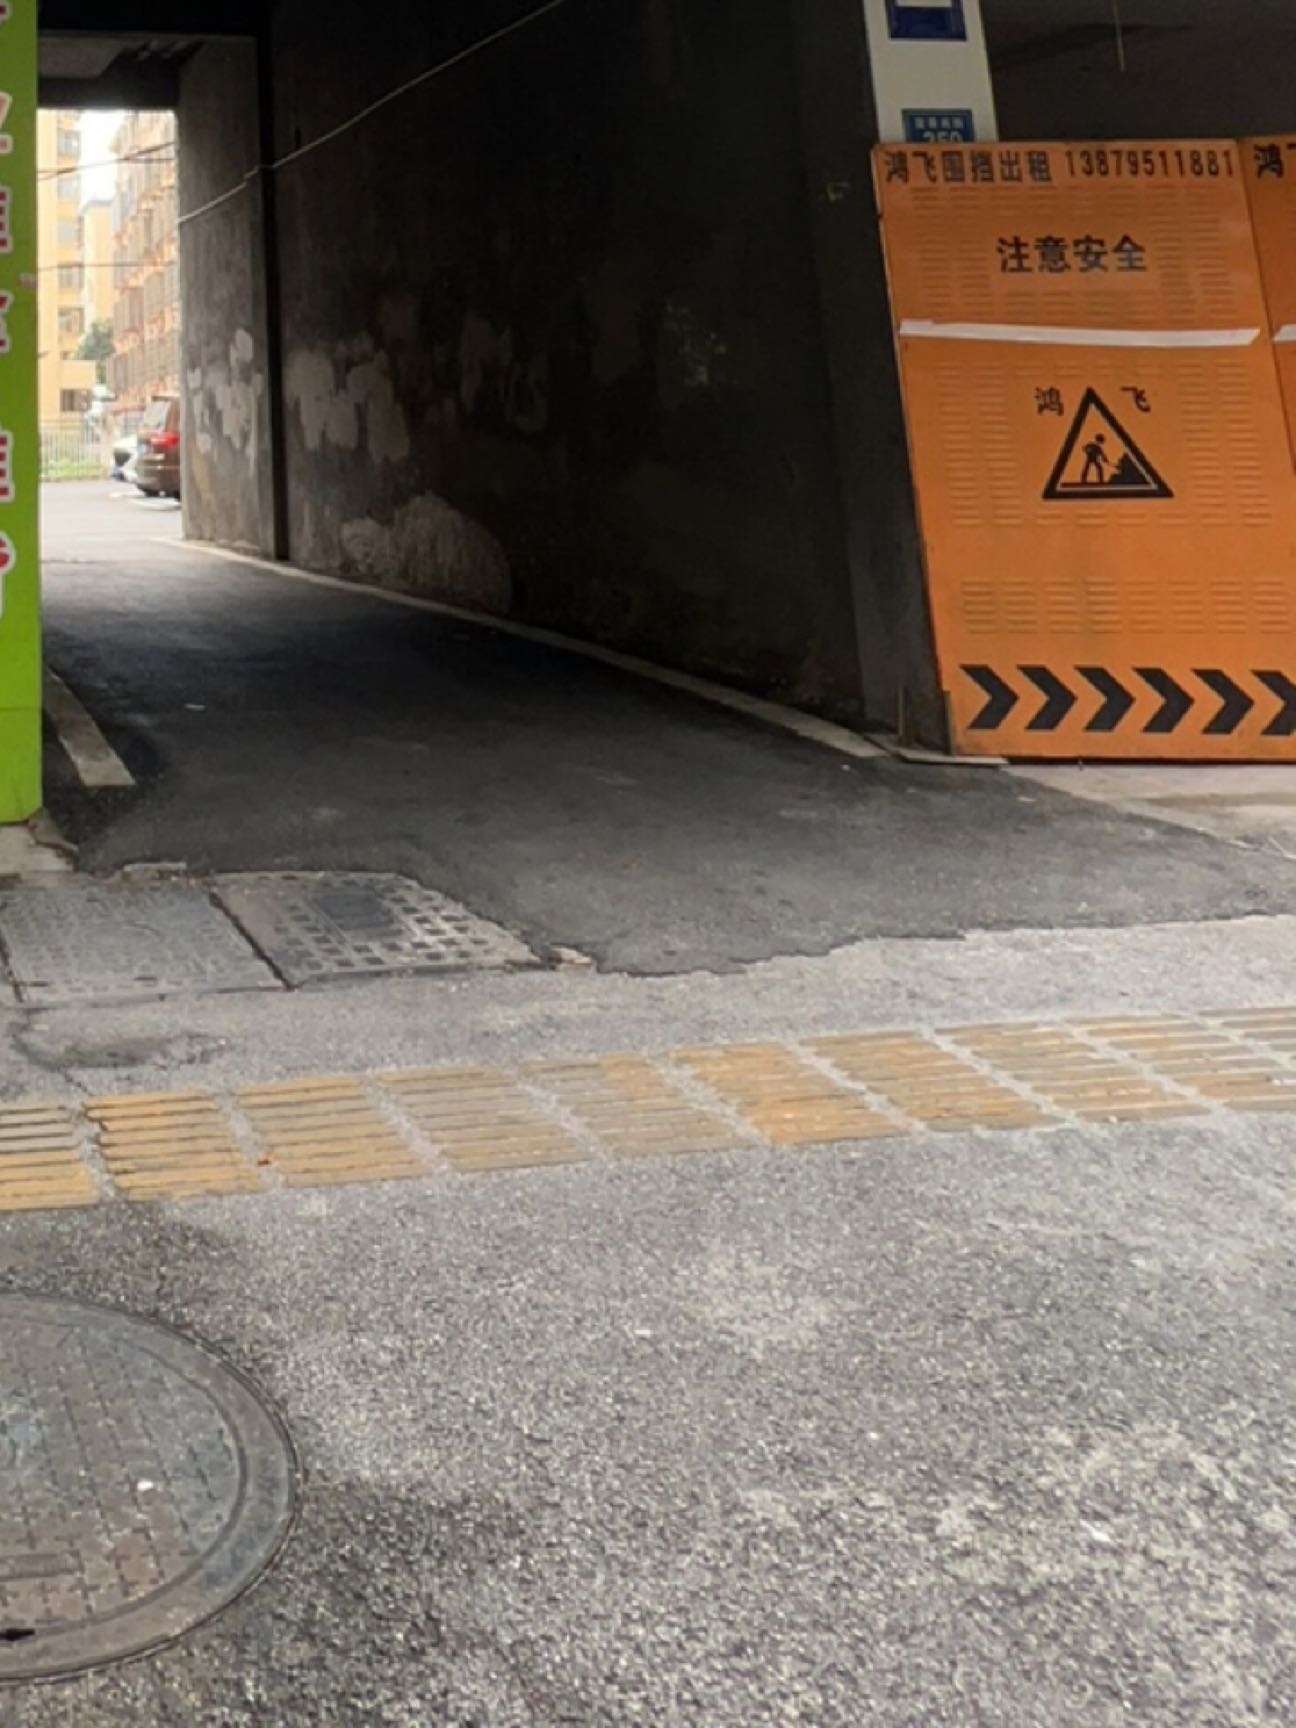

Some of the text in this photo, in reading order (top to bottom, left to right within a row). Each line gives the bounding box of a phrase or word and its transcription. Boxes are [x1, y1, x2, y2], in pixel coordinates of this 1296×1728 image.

[885, 150, 1234, 184] 鸿飞围挡出租 13879511881
[1253, 142, 1296, 179] 鸿
[996, 235, 1146, 273] 注意安全
[1035, 387, 1151, 416] 鸿 飞
